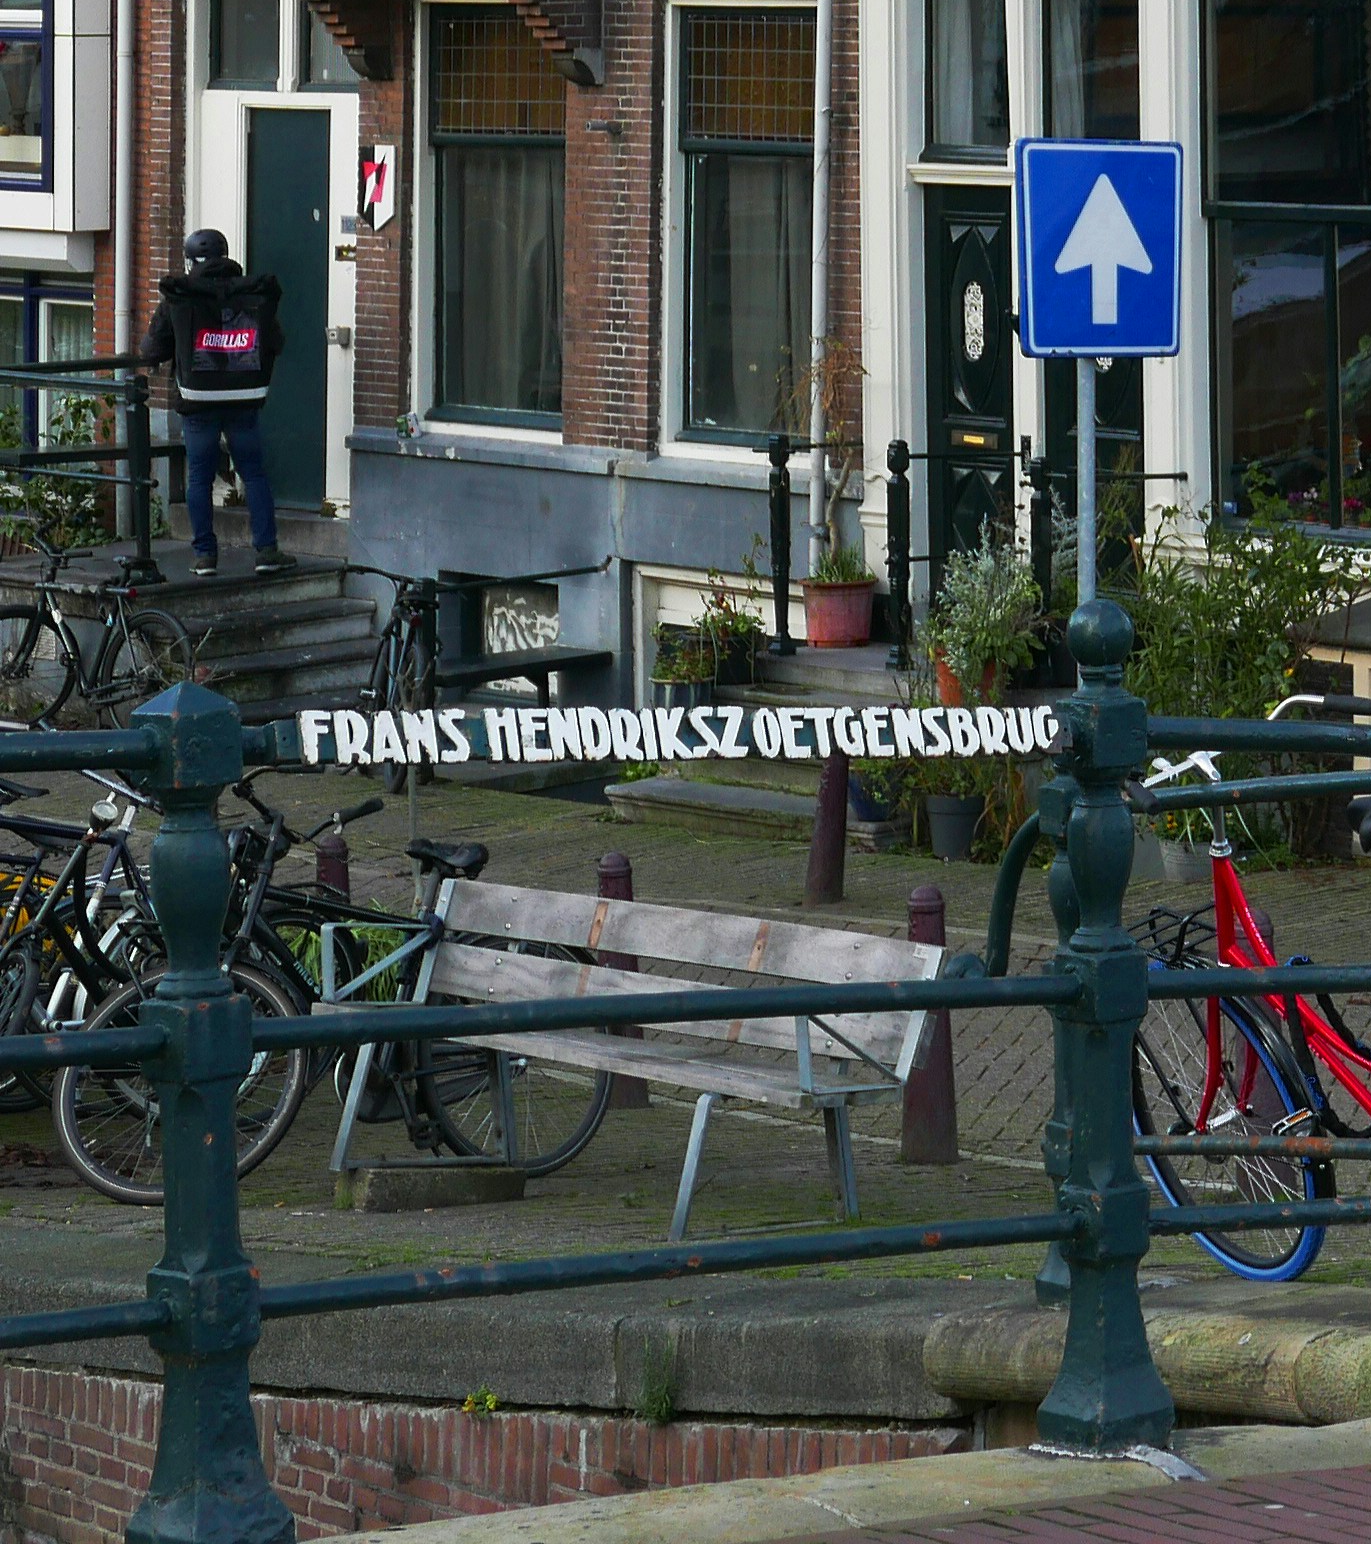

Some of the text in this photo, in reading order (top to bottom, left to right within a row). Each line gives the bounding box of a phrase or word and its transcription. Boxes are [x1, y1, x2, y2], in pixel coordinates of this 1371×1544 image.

[202, 332, 249, 348] GORILLAS
[300, 704, 1059, 765] FRANS HENDRIKSZ OETGENSBRUG
